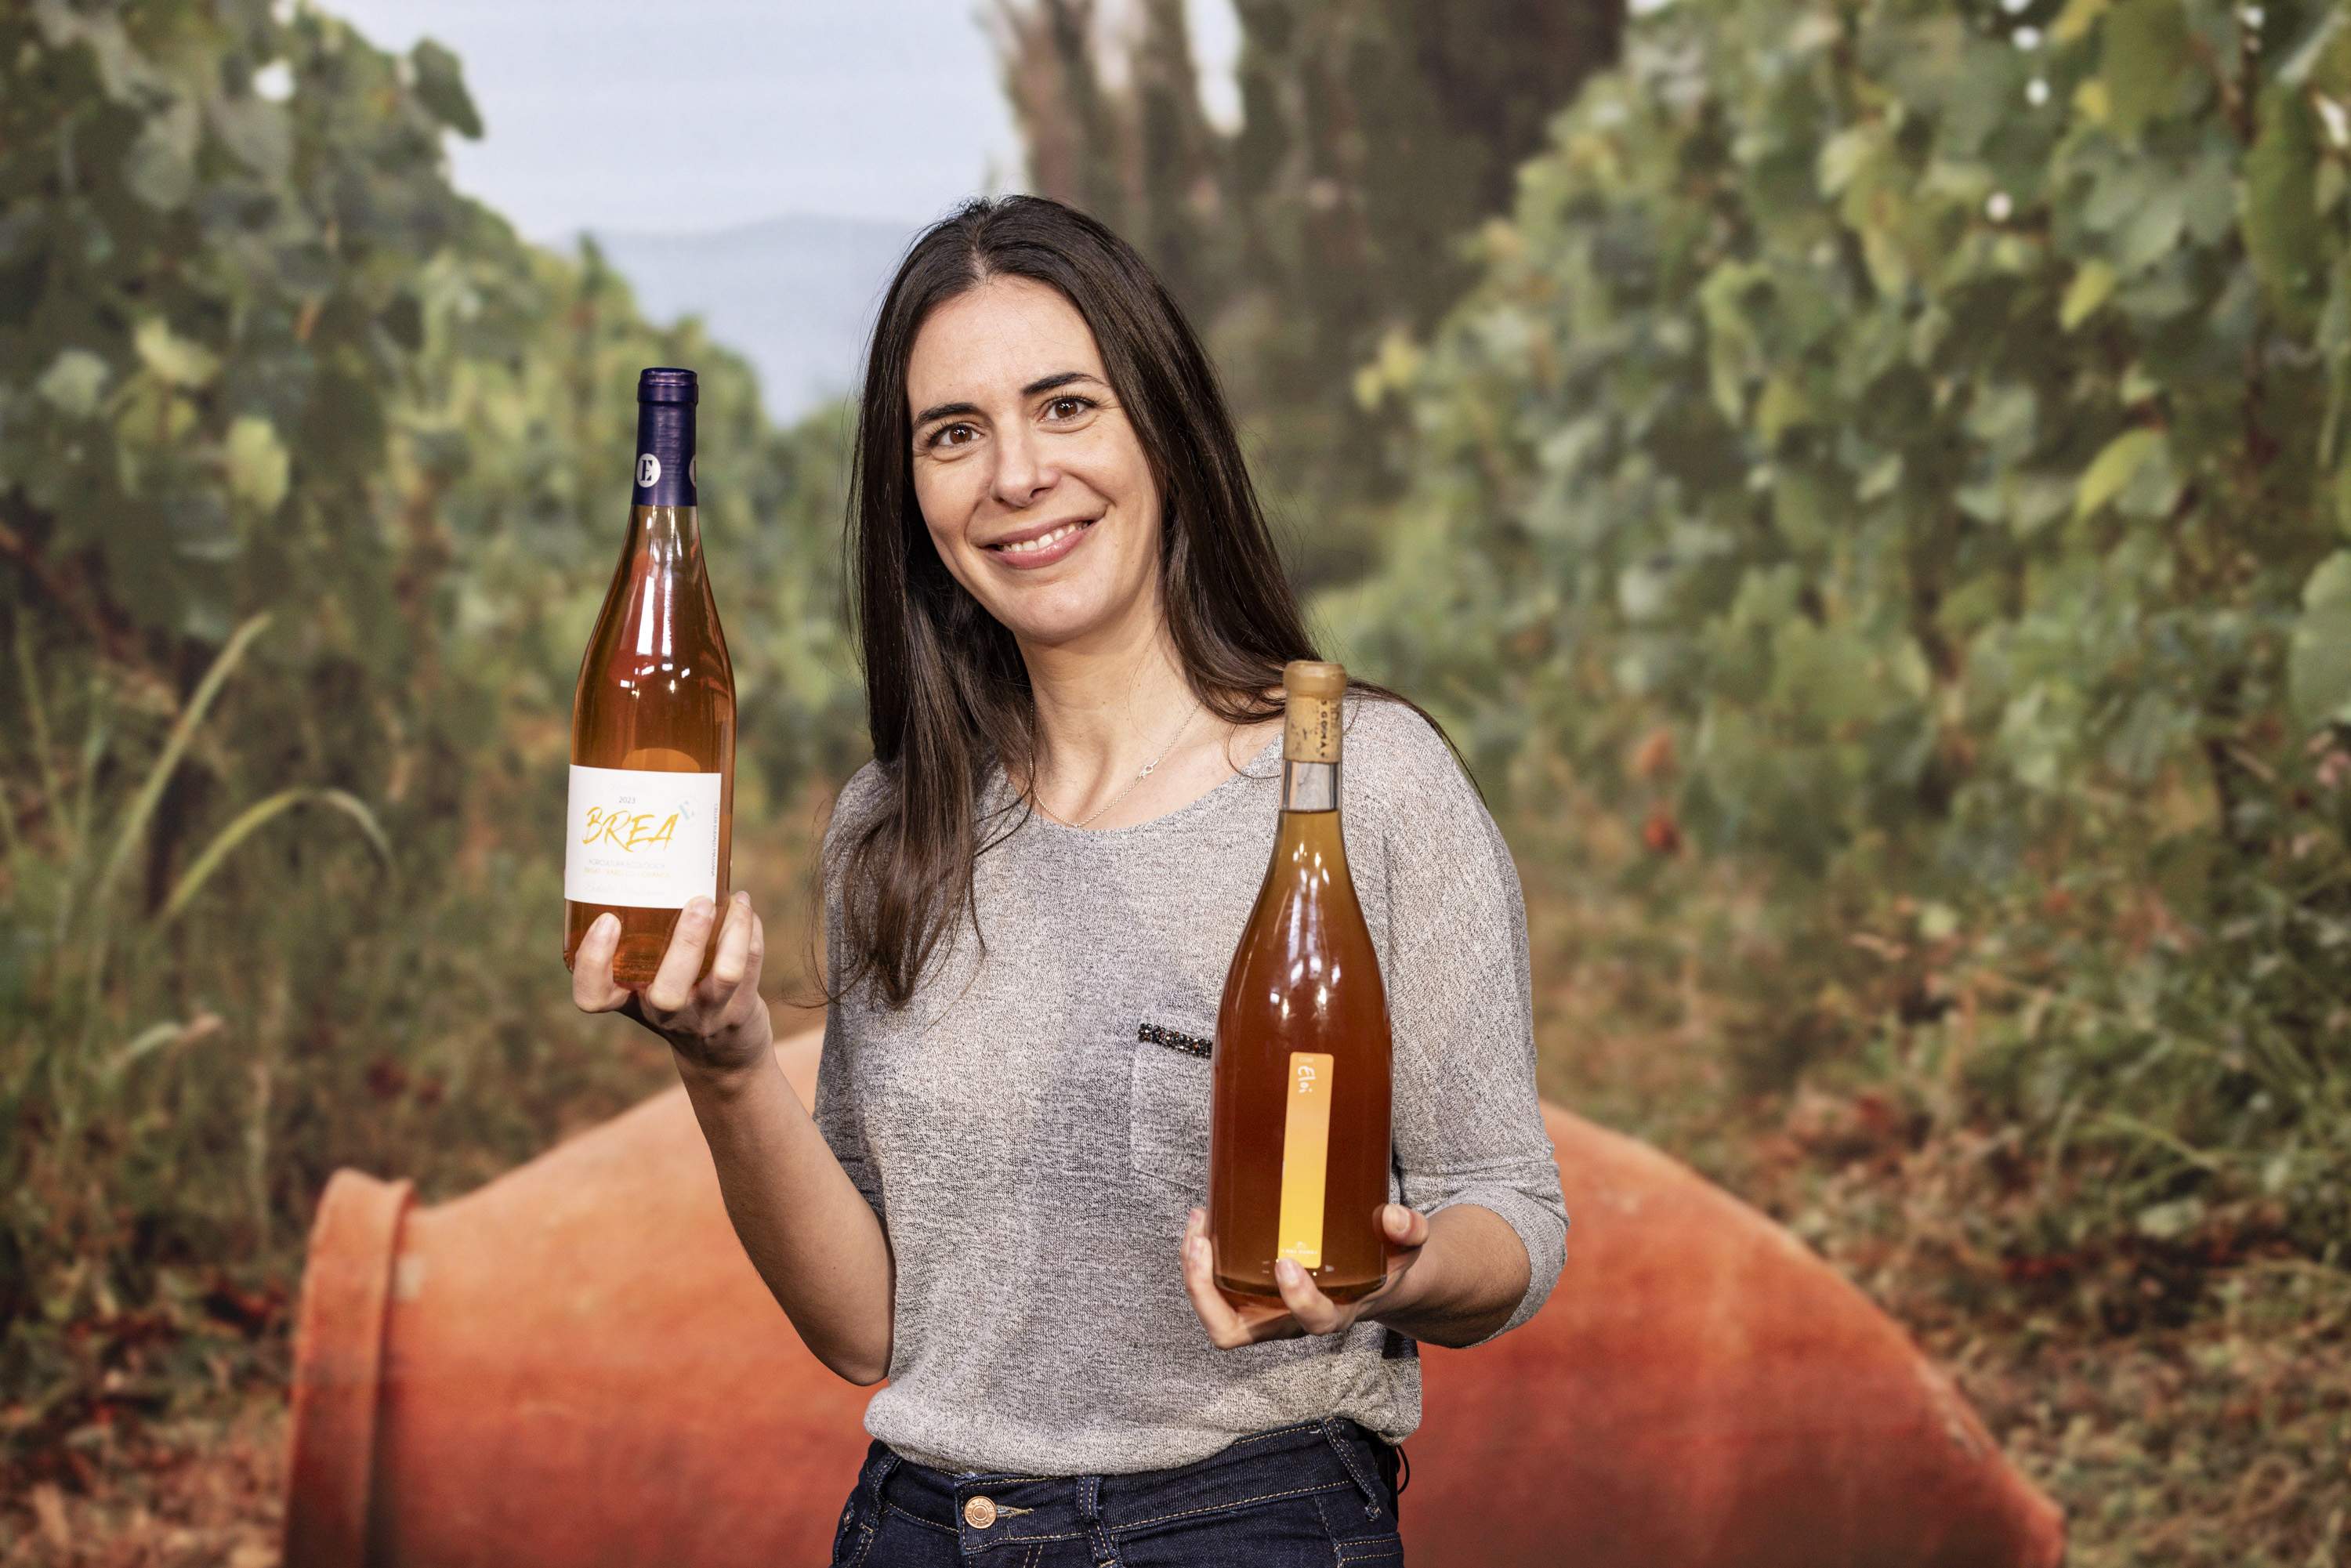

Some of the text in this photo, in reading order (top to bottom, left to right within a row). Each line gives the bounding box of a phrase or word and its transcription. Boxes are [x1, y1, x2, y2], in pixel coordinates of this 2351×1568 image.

[641, 460, 653, 481] E
[582, 806, 679, 853] BREA
[1297, 1065, 1317, 1094] Eloi
